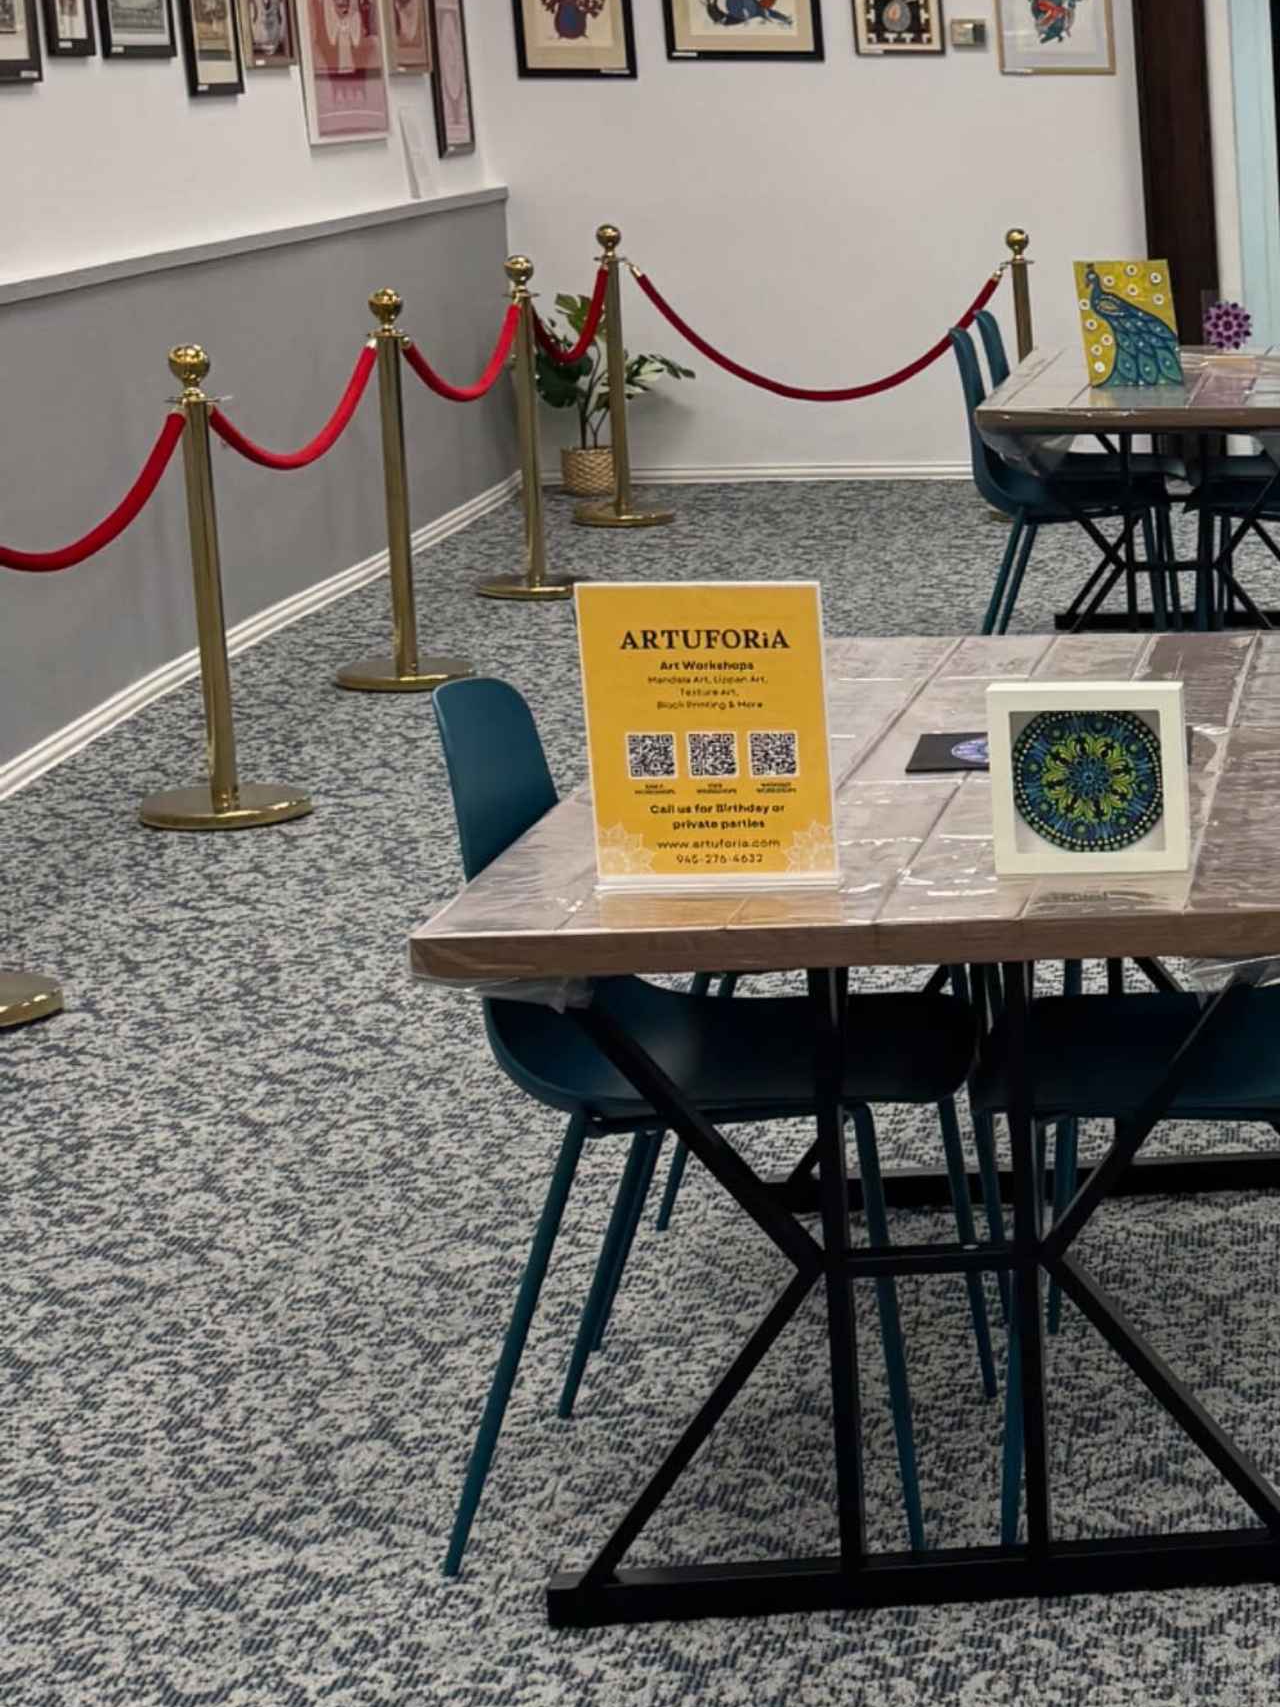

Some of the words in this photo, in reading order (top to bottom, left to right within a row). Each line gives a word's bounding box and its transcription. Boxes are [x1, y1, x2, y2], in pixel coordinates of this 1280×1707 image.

[660, 661, 680, 671] Art
[682, 660, 754, 672] Workshops
[648, 675, 691, 684] Mandala
[680, 688, 718, 697] Texture
[686, 701, 726, 711] Printing
[728, 701, 735, 709] &
[738, 701, 763, 709] More
[650, 804, 675, 815] Call
[677, 805, 691, 814] us
[694, 804, 713, 814] for
[716, 803, 769, 815] Birthday
[772, 805, 785, 813] or
[672, 819, 718, 830] private
[721, 818, 765, 830] parties
[656, 839, 782, 850] www.artuforia.com
